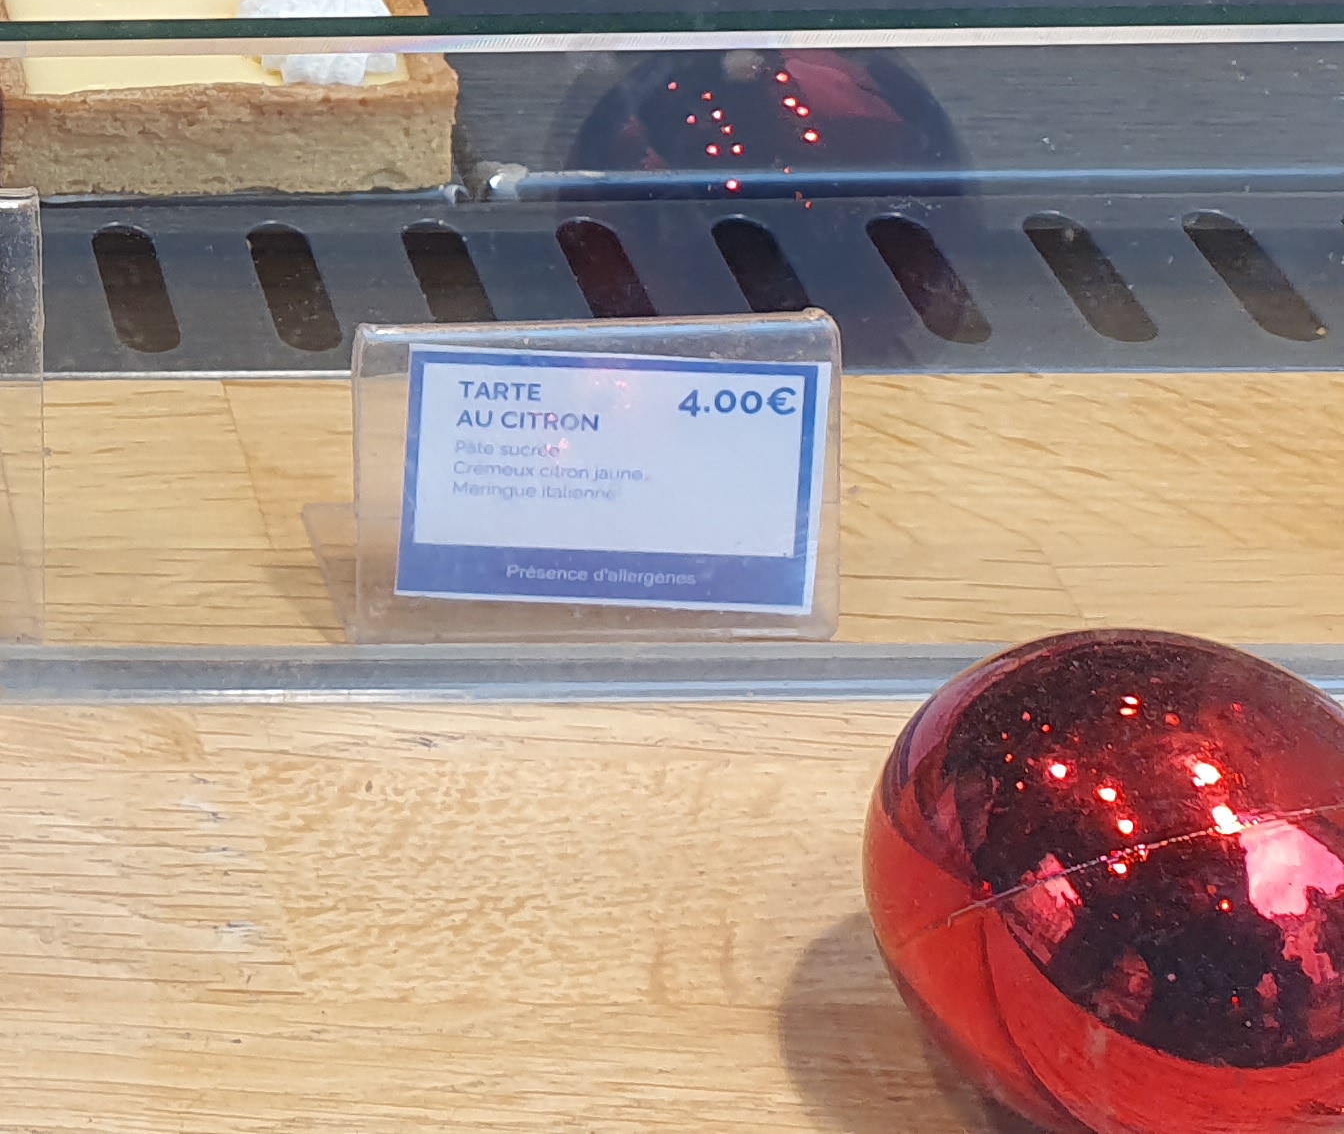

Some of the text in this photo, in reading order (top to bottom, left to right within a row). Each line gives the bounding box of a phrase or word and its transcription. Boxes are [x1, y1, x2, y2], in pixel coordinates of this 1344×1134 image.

[458, 380, 542, 402] TARTE
[678, 387, 797, 418] 4.00€
[455, 409, 600, 432] AU CITRON
[539, 463, 590, 480] citron
[505, 564, 589, 582] Présence
